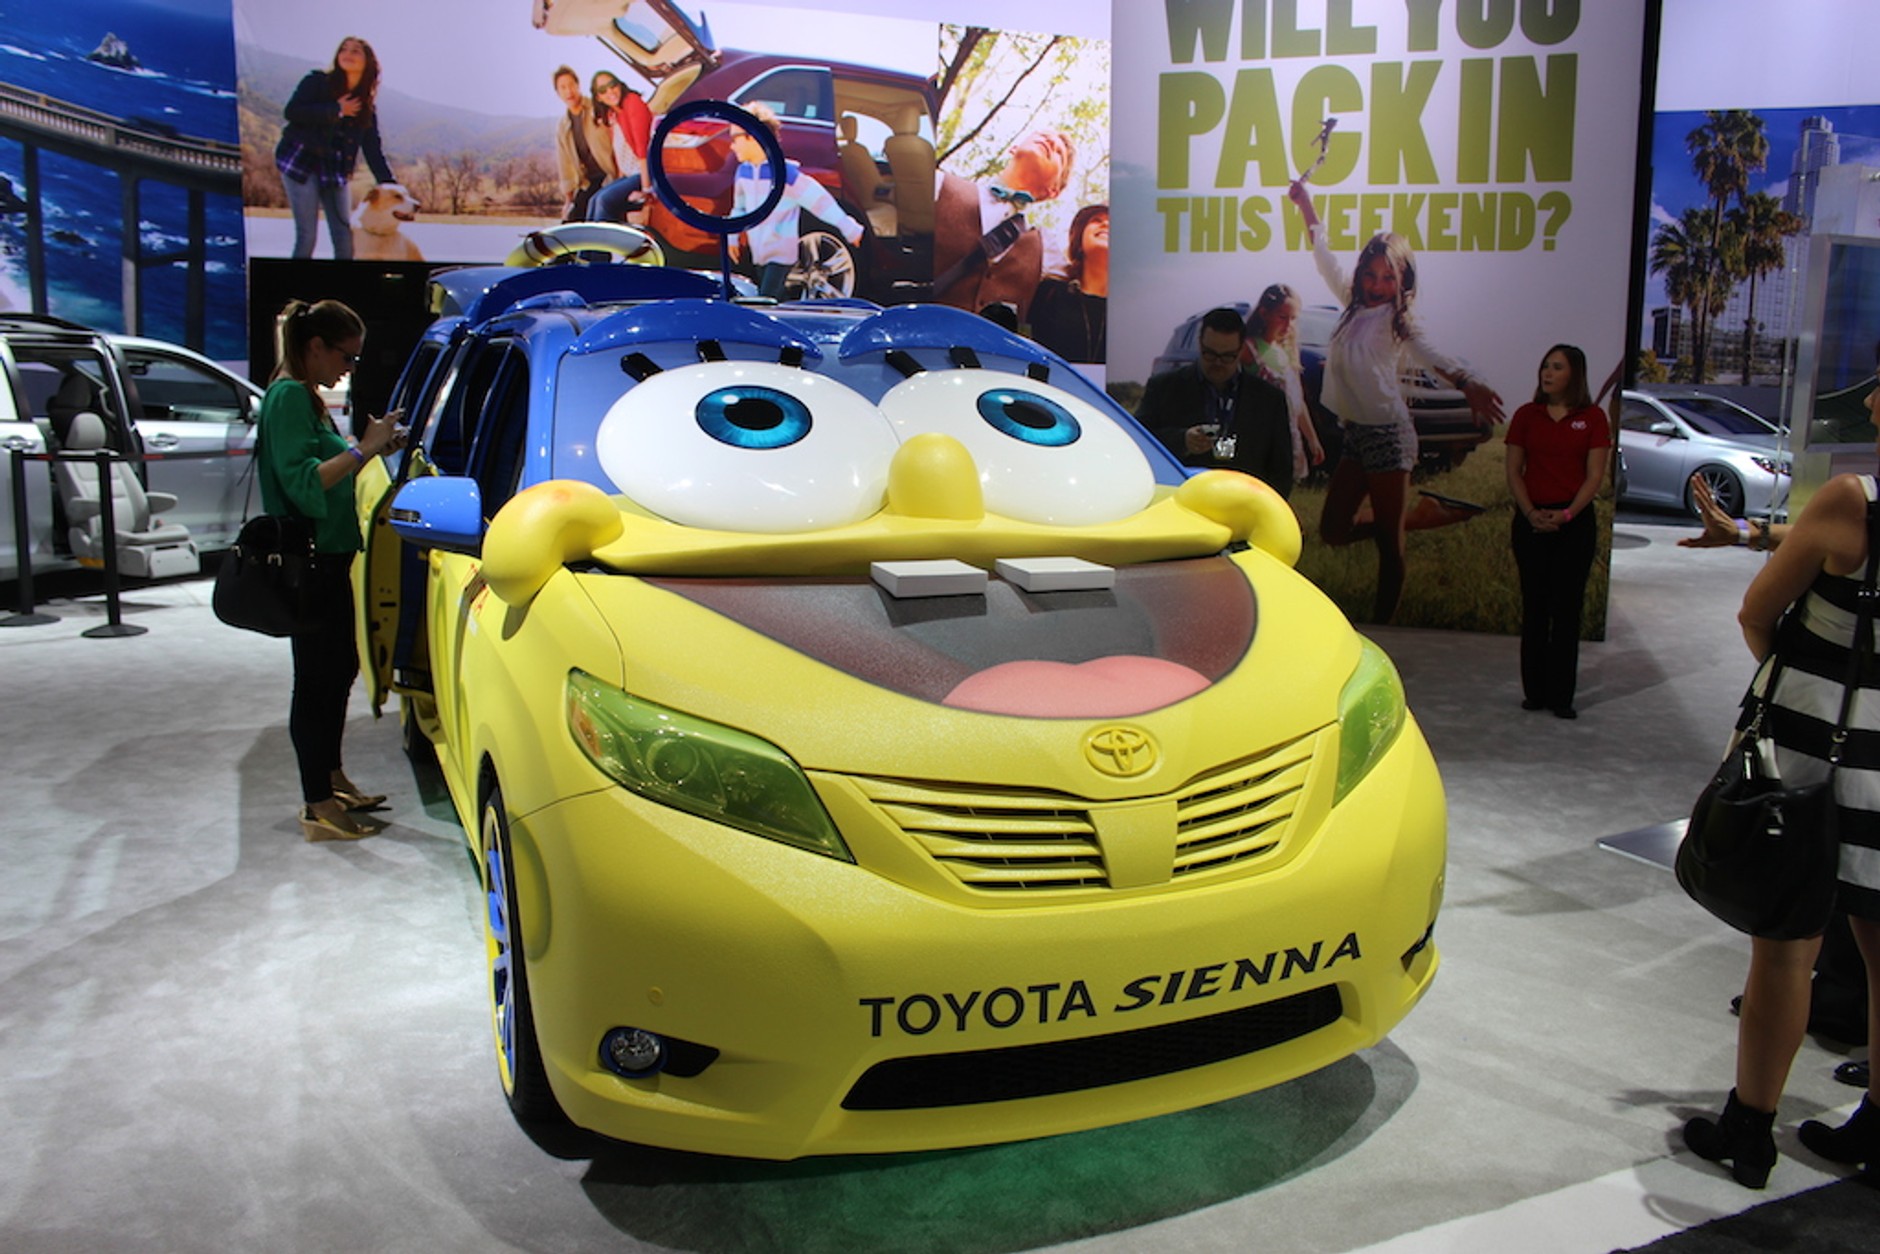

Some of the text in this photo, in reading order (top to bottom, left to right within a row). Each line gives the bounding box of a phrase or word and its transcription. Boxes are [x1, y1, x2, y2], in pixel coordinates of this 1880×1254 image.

[1165, 0, 1378, 64] WILL
[1156, 53, 1578, 189] PACK IN
[1156, 190, 1572, 253] THIS WEEKEND?
[859, 931, 1362, 1037] TOYOTA SIENNA
